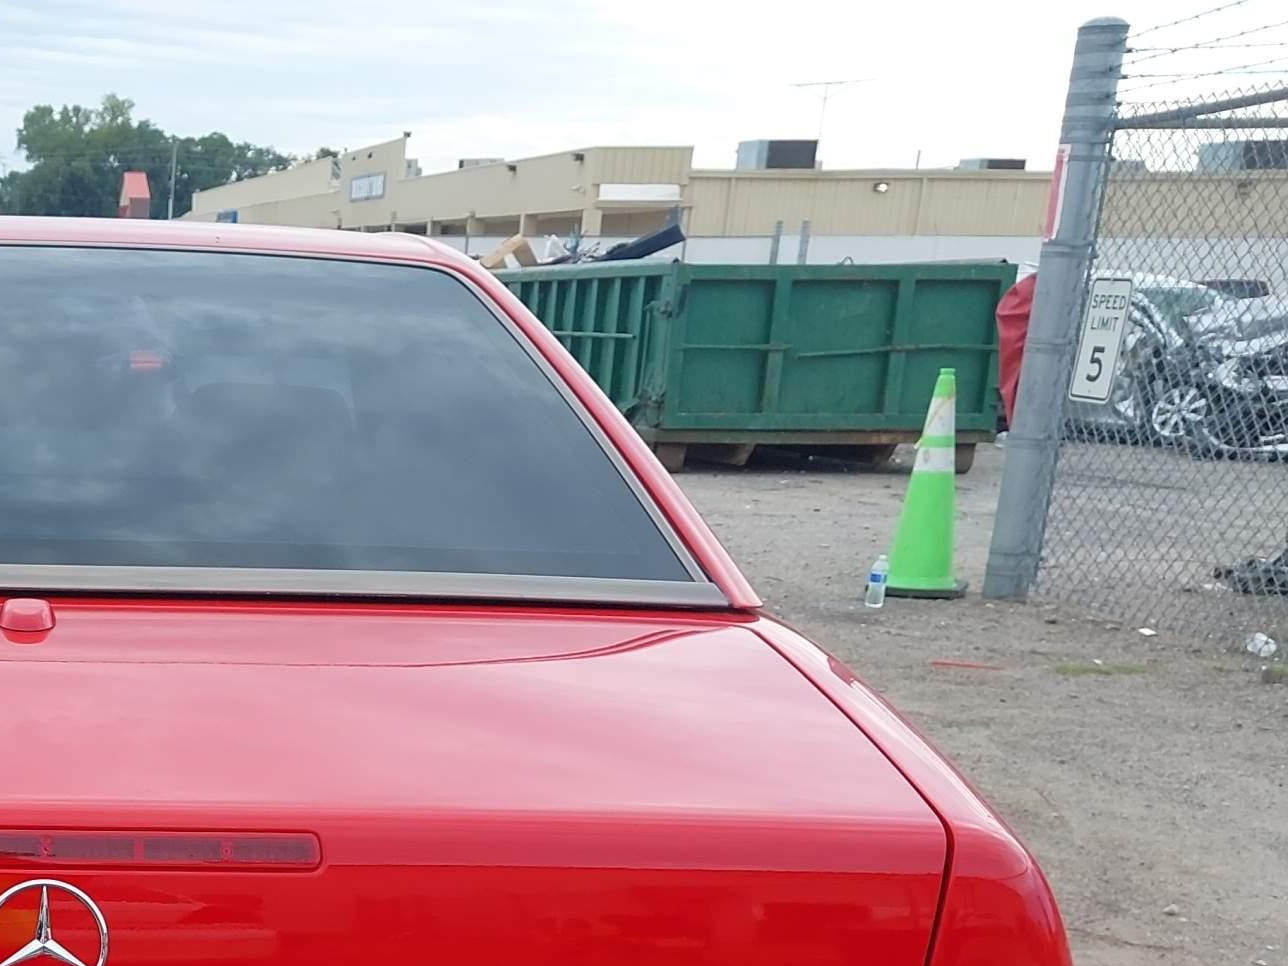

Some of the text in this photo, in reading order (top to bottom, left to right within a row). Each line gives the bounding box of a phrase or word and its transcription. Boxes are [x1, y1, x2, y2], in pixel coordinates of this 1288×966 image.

[1092, 294, 1126, 310] SPEED
[1091, 316, 1120, 332] LIMIT
[1086, 346, 1105, 382] 5
